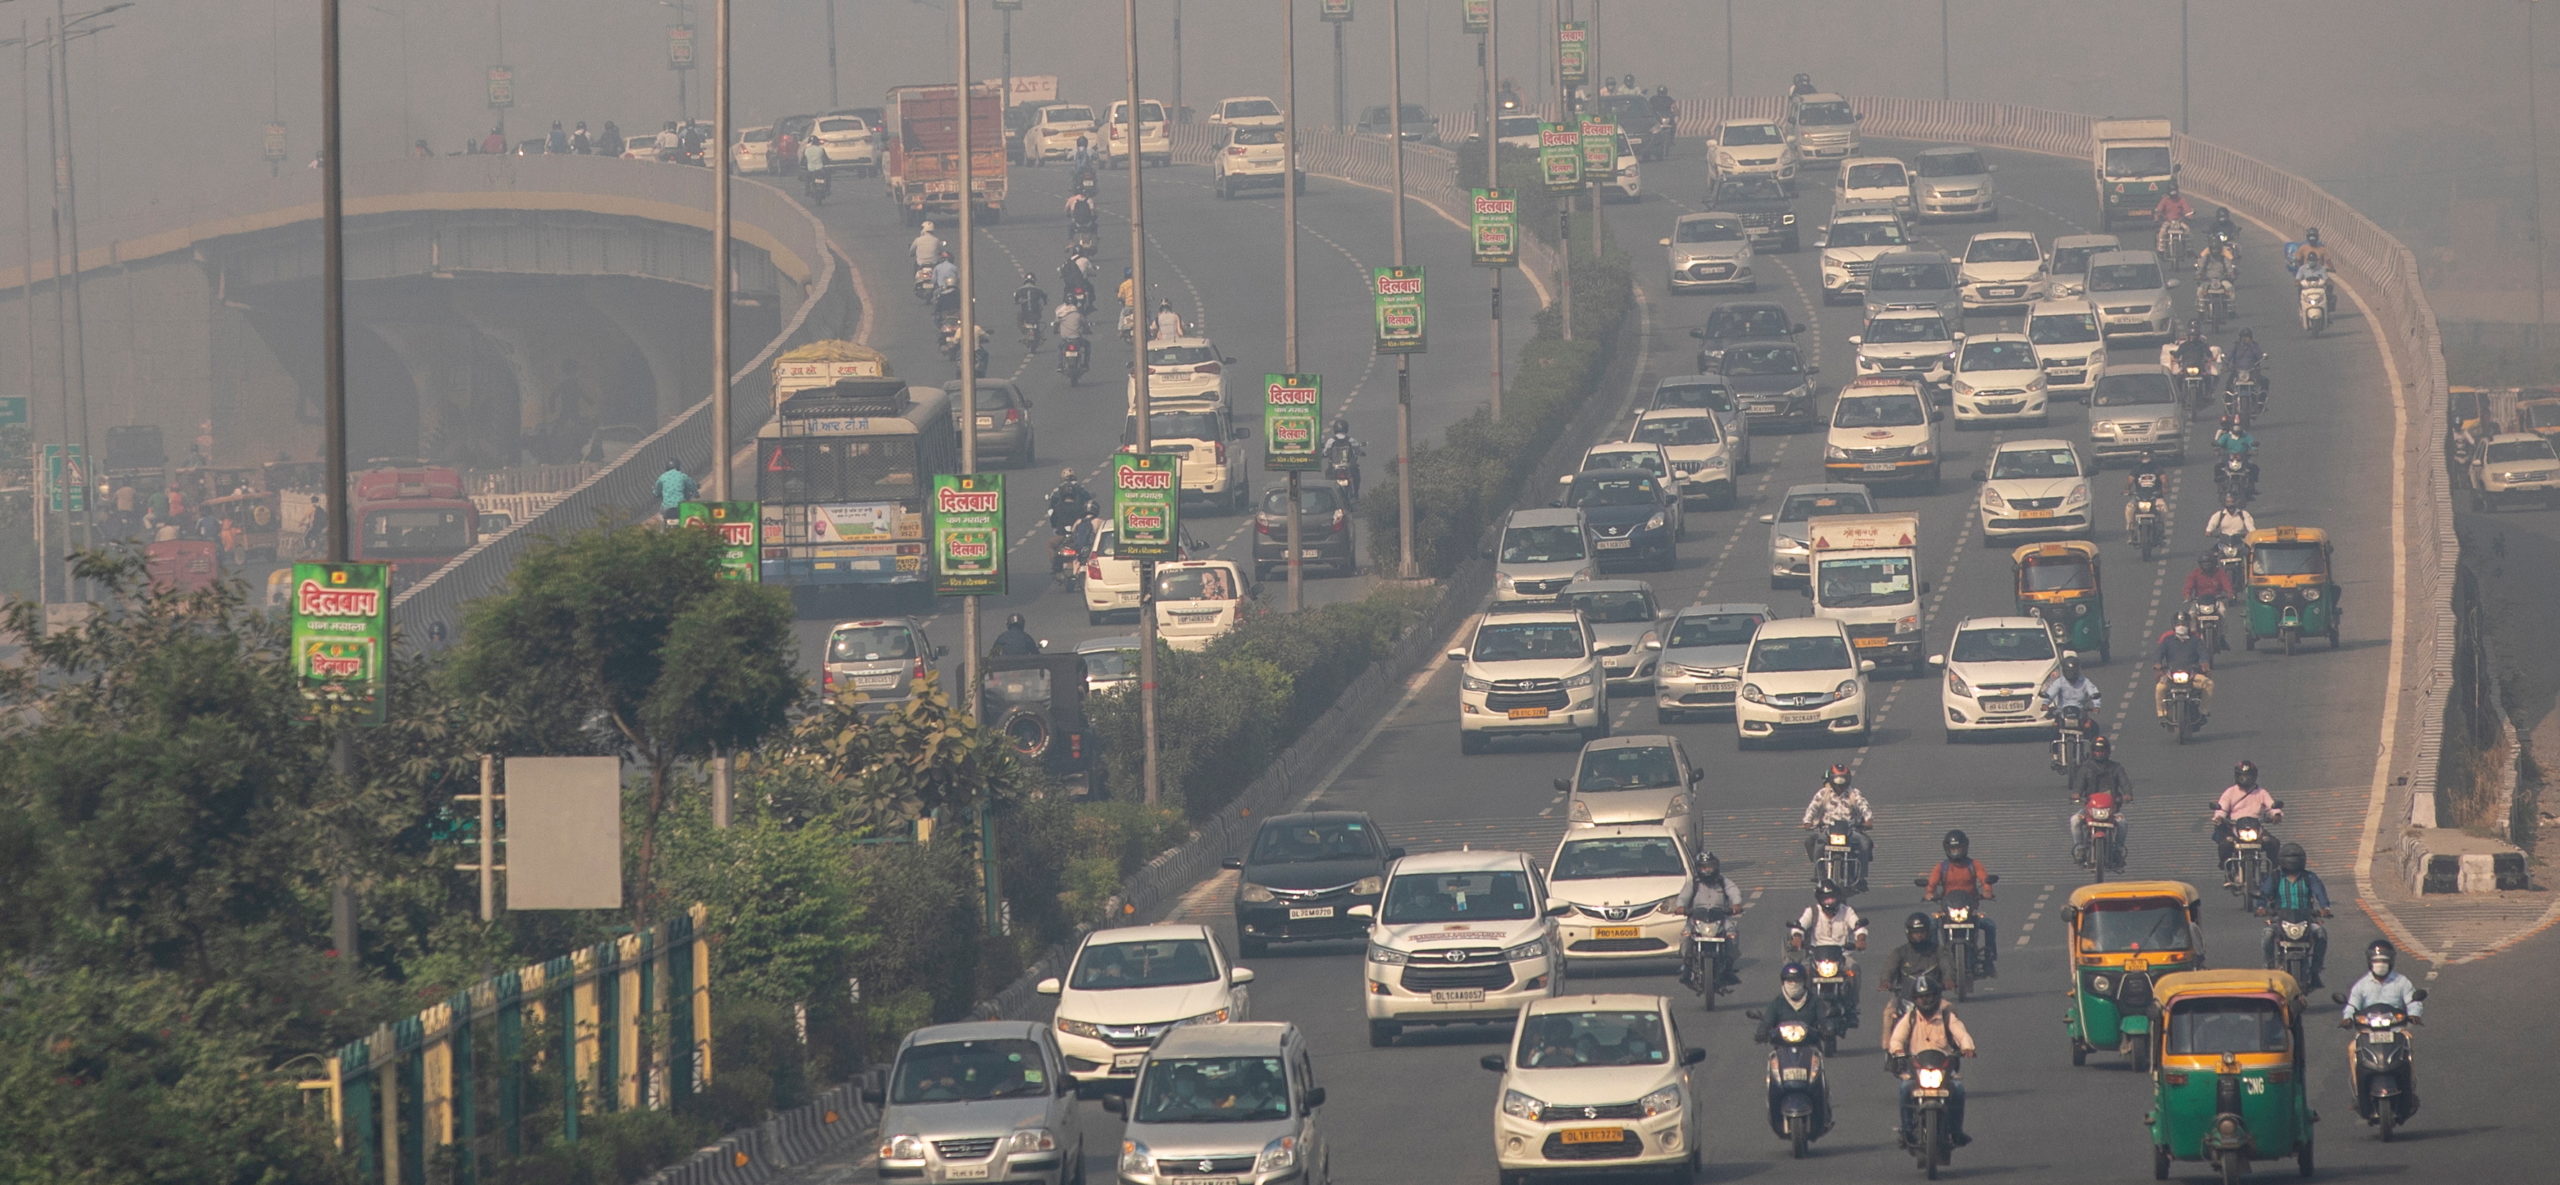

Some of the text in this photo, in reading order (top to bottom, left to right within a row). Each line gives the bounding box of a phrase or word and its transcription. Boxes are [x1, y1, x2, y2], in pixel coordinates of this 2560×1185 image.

[1474, 195, 1514, 214] दिलबाग
[1377, 275, 1421, 295] दिलबाग
[1268, 384, 1317, 404] दिलबाग
[1278, 427, 1307, 440] दिलबाग
[1117, 465, 1171, 489] दिलबाग
[937, 486, 998, 513] दिलबाग
[1128, 513, 1161, 528] दिलबाग
[950, 541, 987, 556] दिलबाग
[299, 579, 379, 617] दिलबाग
[307, 621, 366, 632] पान मसाला
[312, 652, 362, 677] दिलबाग
